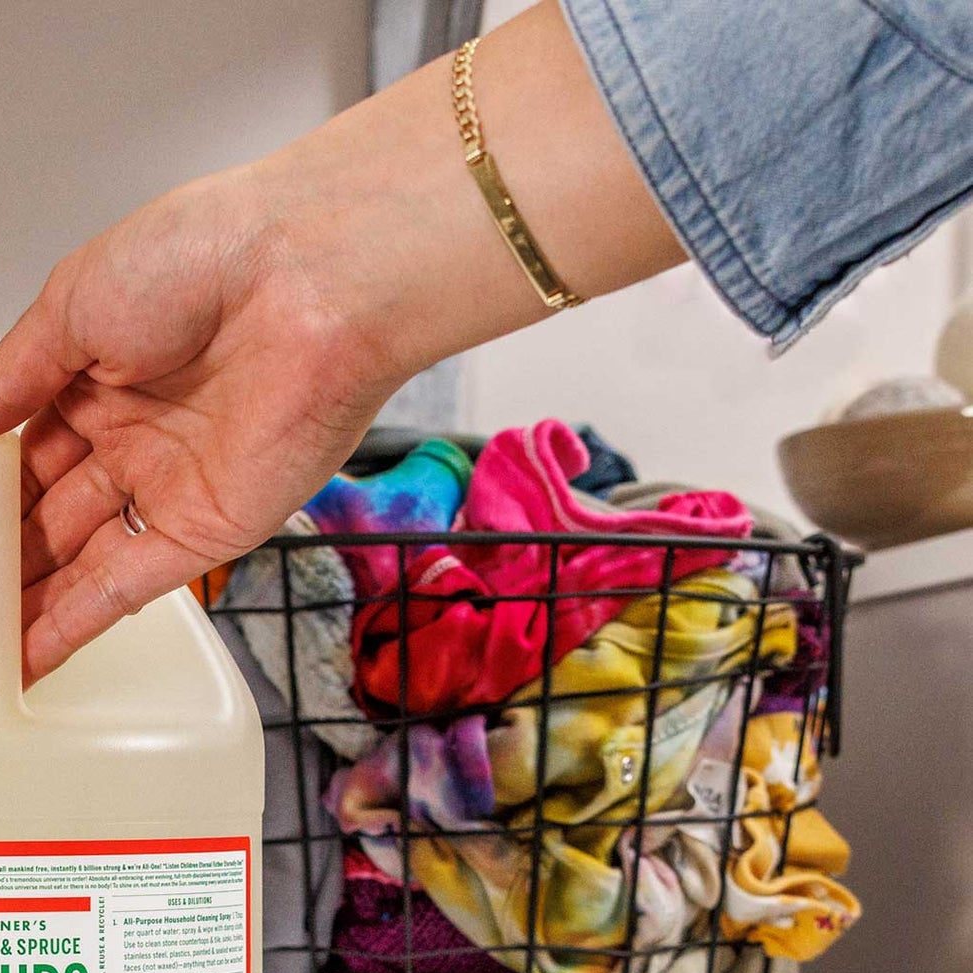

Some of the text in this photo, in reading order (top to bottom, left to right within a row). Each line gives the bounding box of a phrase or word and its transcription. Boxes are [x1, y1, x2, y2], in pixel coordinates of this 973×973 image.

[51, 865, 77, 873] instantly
[124, 916, 162, 927] All-Purpose
[165, 915, 195, 923] Household
[197, 914, 218, 923] Cleaning
[1, 939, 12, 955] &
[17, 938, 81, 955] SPRUCE
